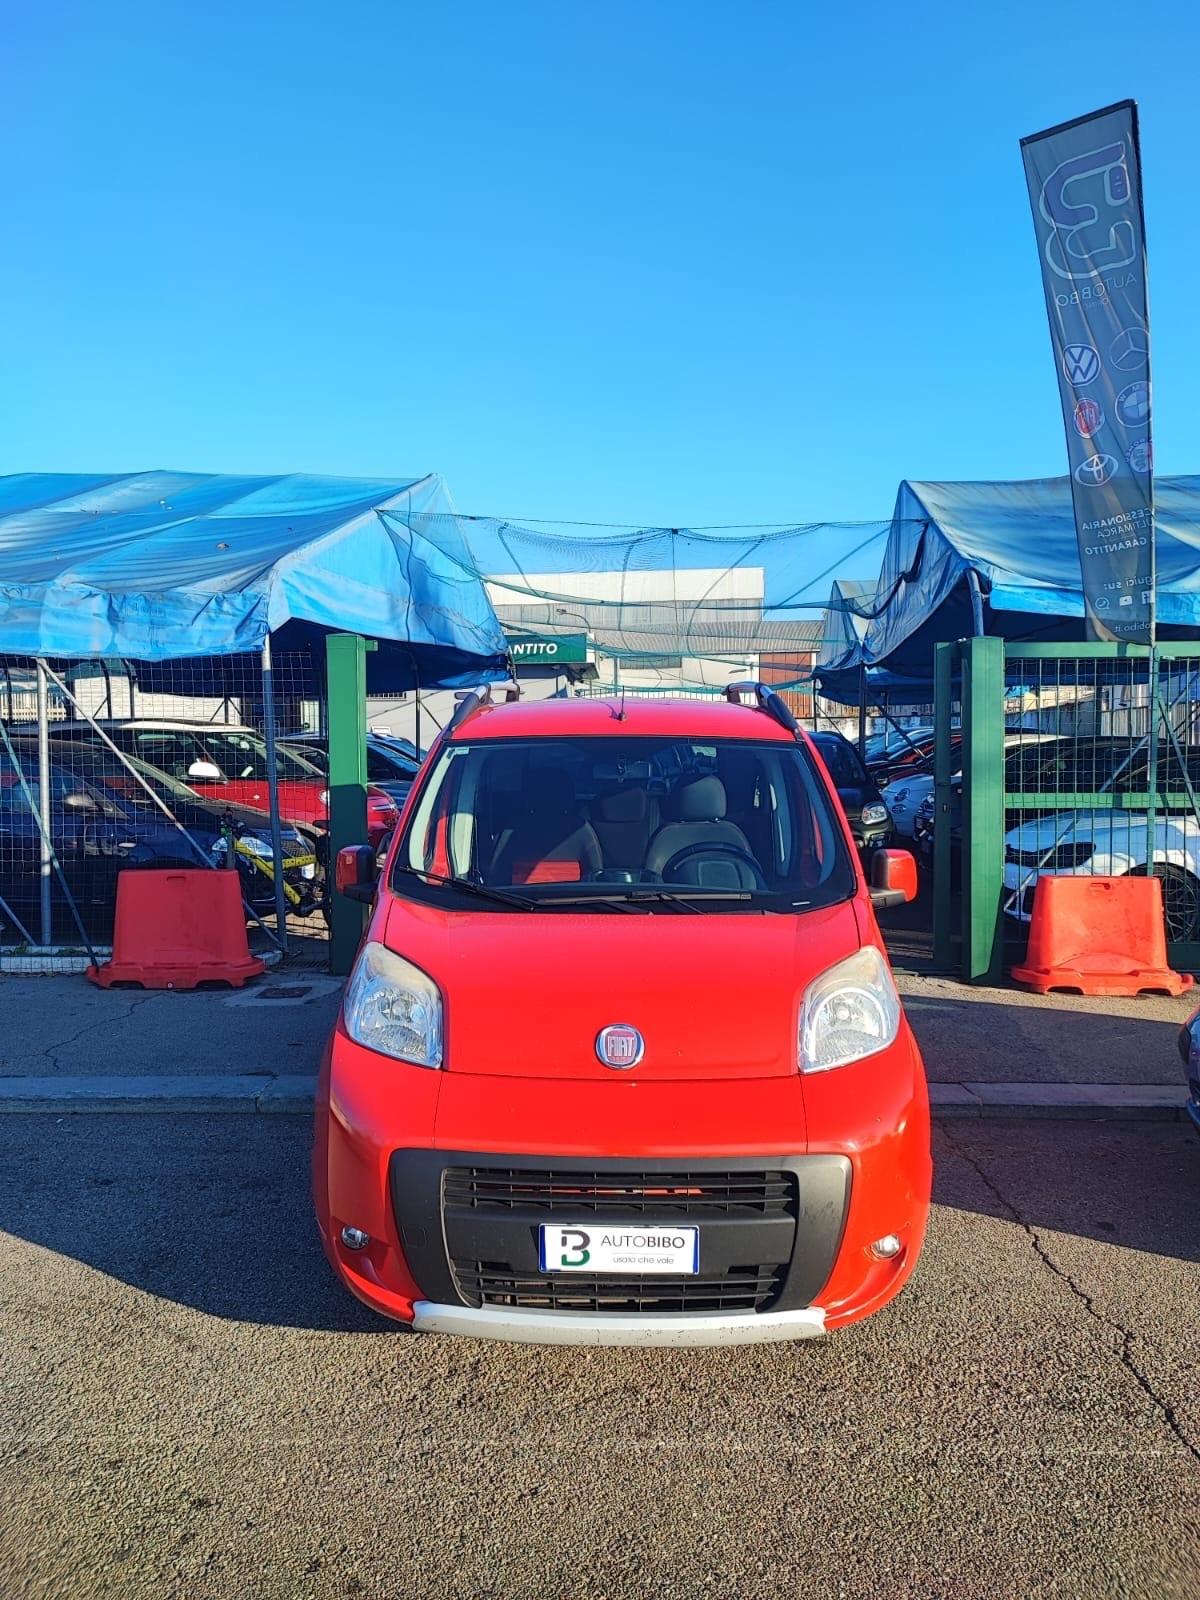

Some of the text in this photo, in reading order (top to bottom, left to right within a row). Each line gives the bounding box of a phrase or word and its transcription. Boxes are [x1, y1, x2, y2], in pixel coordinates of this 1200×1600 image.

[607, 1036, 634, 1057] FIAT
[601, 1235, 686, 1249] AUTOBIBO
[612, 1255, 636, 1264] usato
[637, 1256, 655, 1264] che
